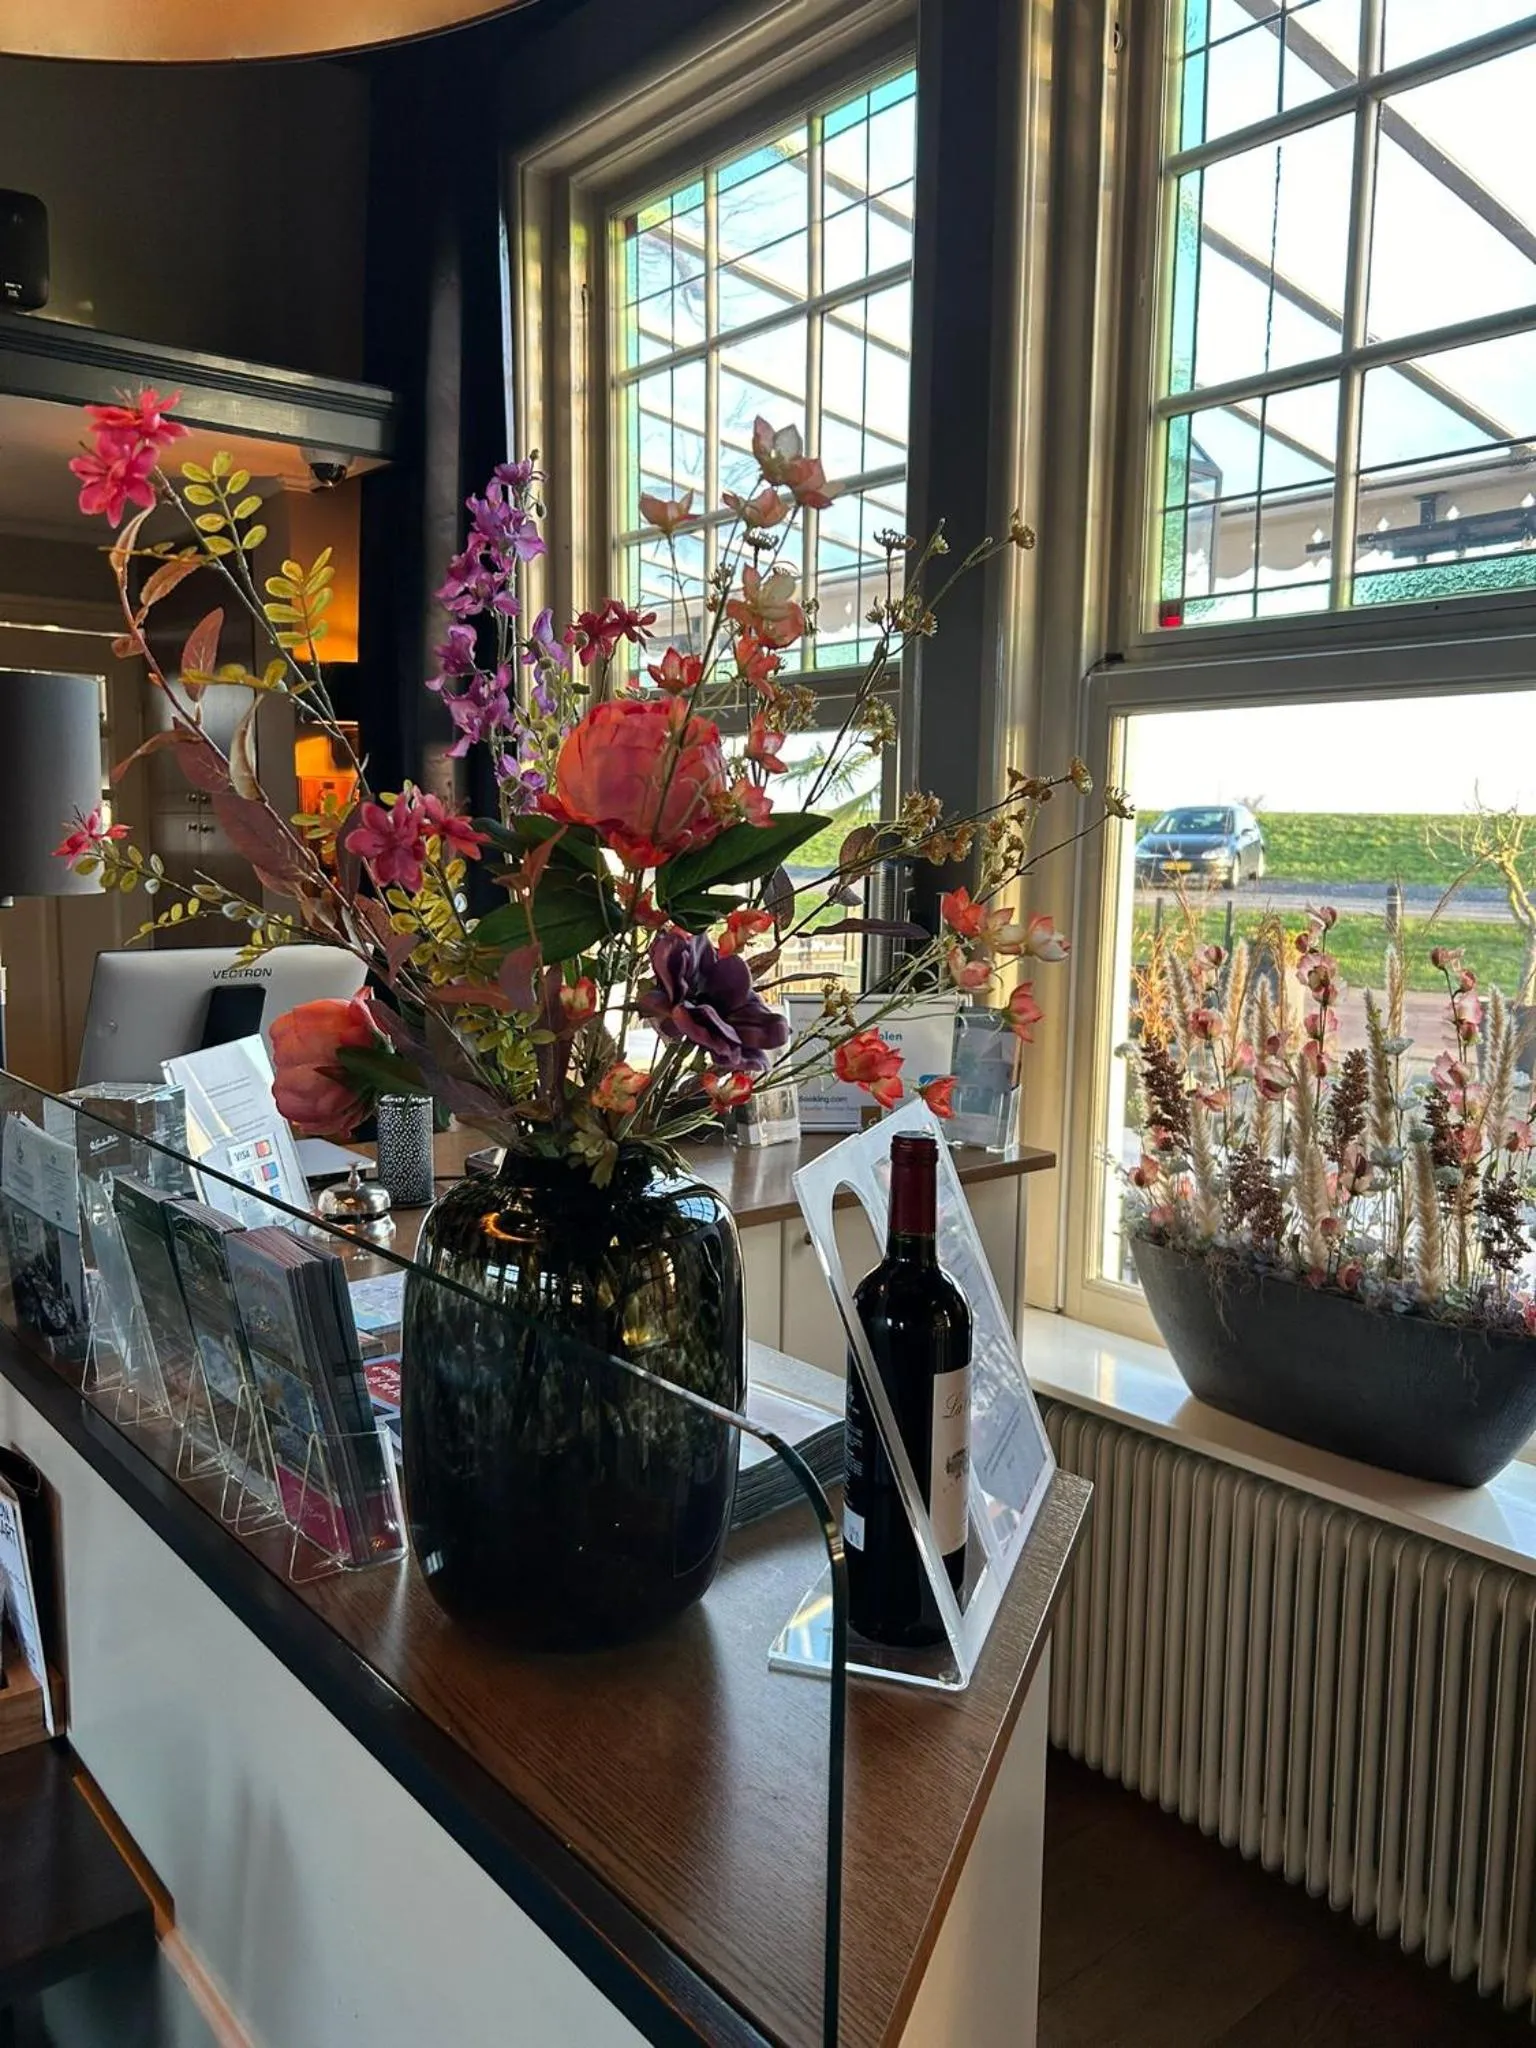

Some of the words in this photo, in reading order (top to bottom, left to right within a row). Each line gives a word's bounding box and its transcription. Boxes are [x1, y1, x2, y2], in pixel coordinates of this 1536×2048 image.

[212, 967, 273, 980] VECTRON
[879, 1031, 903, 1041] olen
[233, 1149, 250, 1162] VISA
